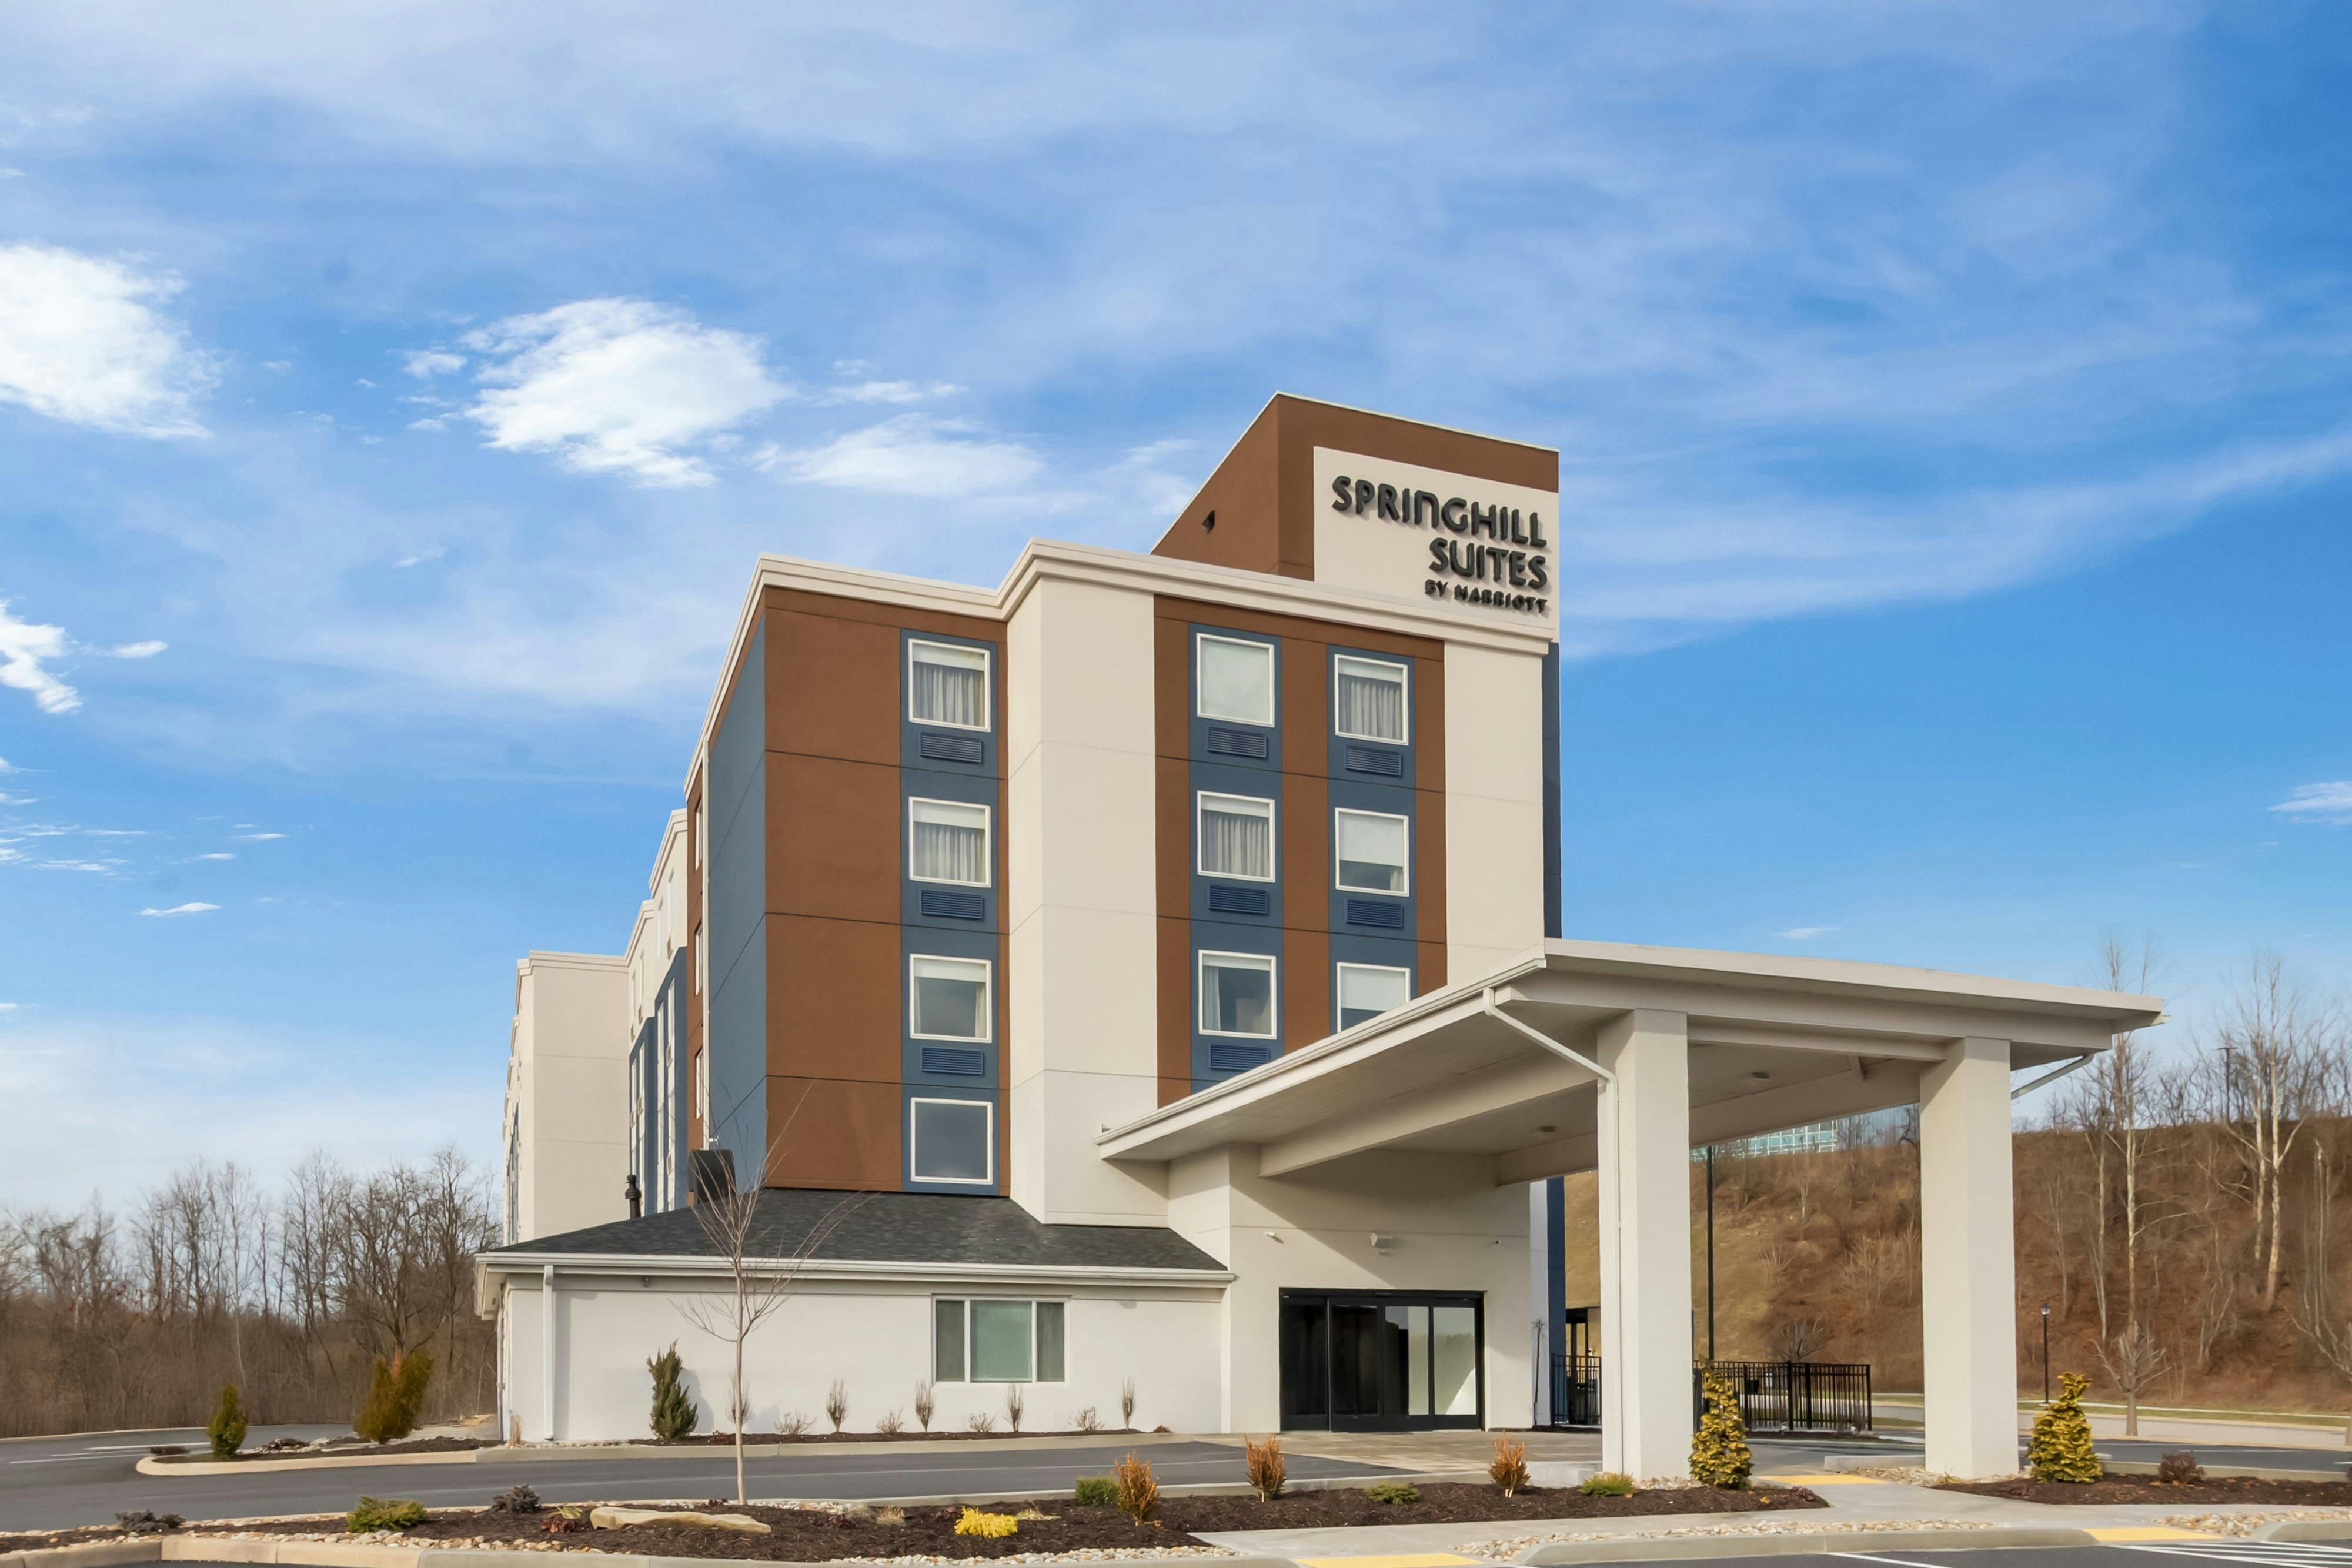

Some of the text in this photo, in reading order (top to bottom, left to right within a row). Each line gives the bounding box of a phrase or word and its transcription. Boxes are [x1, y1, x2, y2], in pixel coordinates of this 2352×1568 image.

[1332, 476, 1547, 547] SPRINGHILL
[1429, 537, 1548, 589] SUITES
[1425, 579, 1548, 613] BY MARRIOTT
